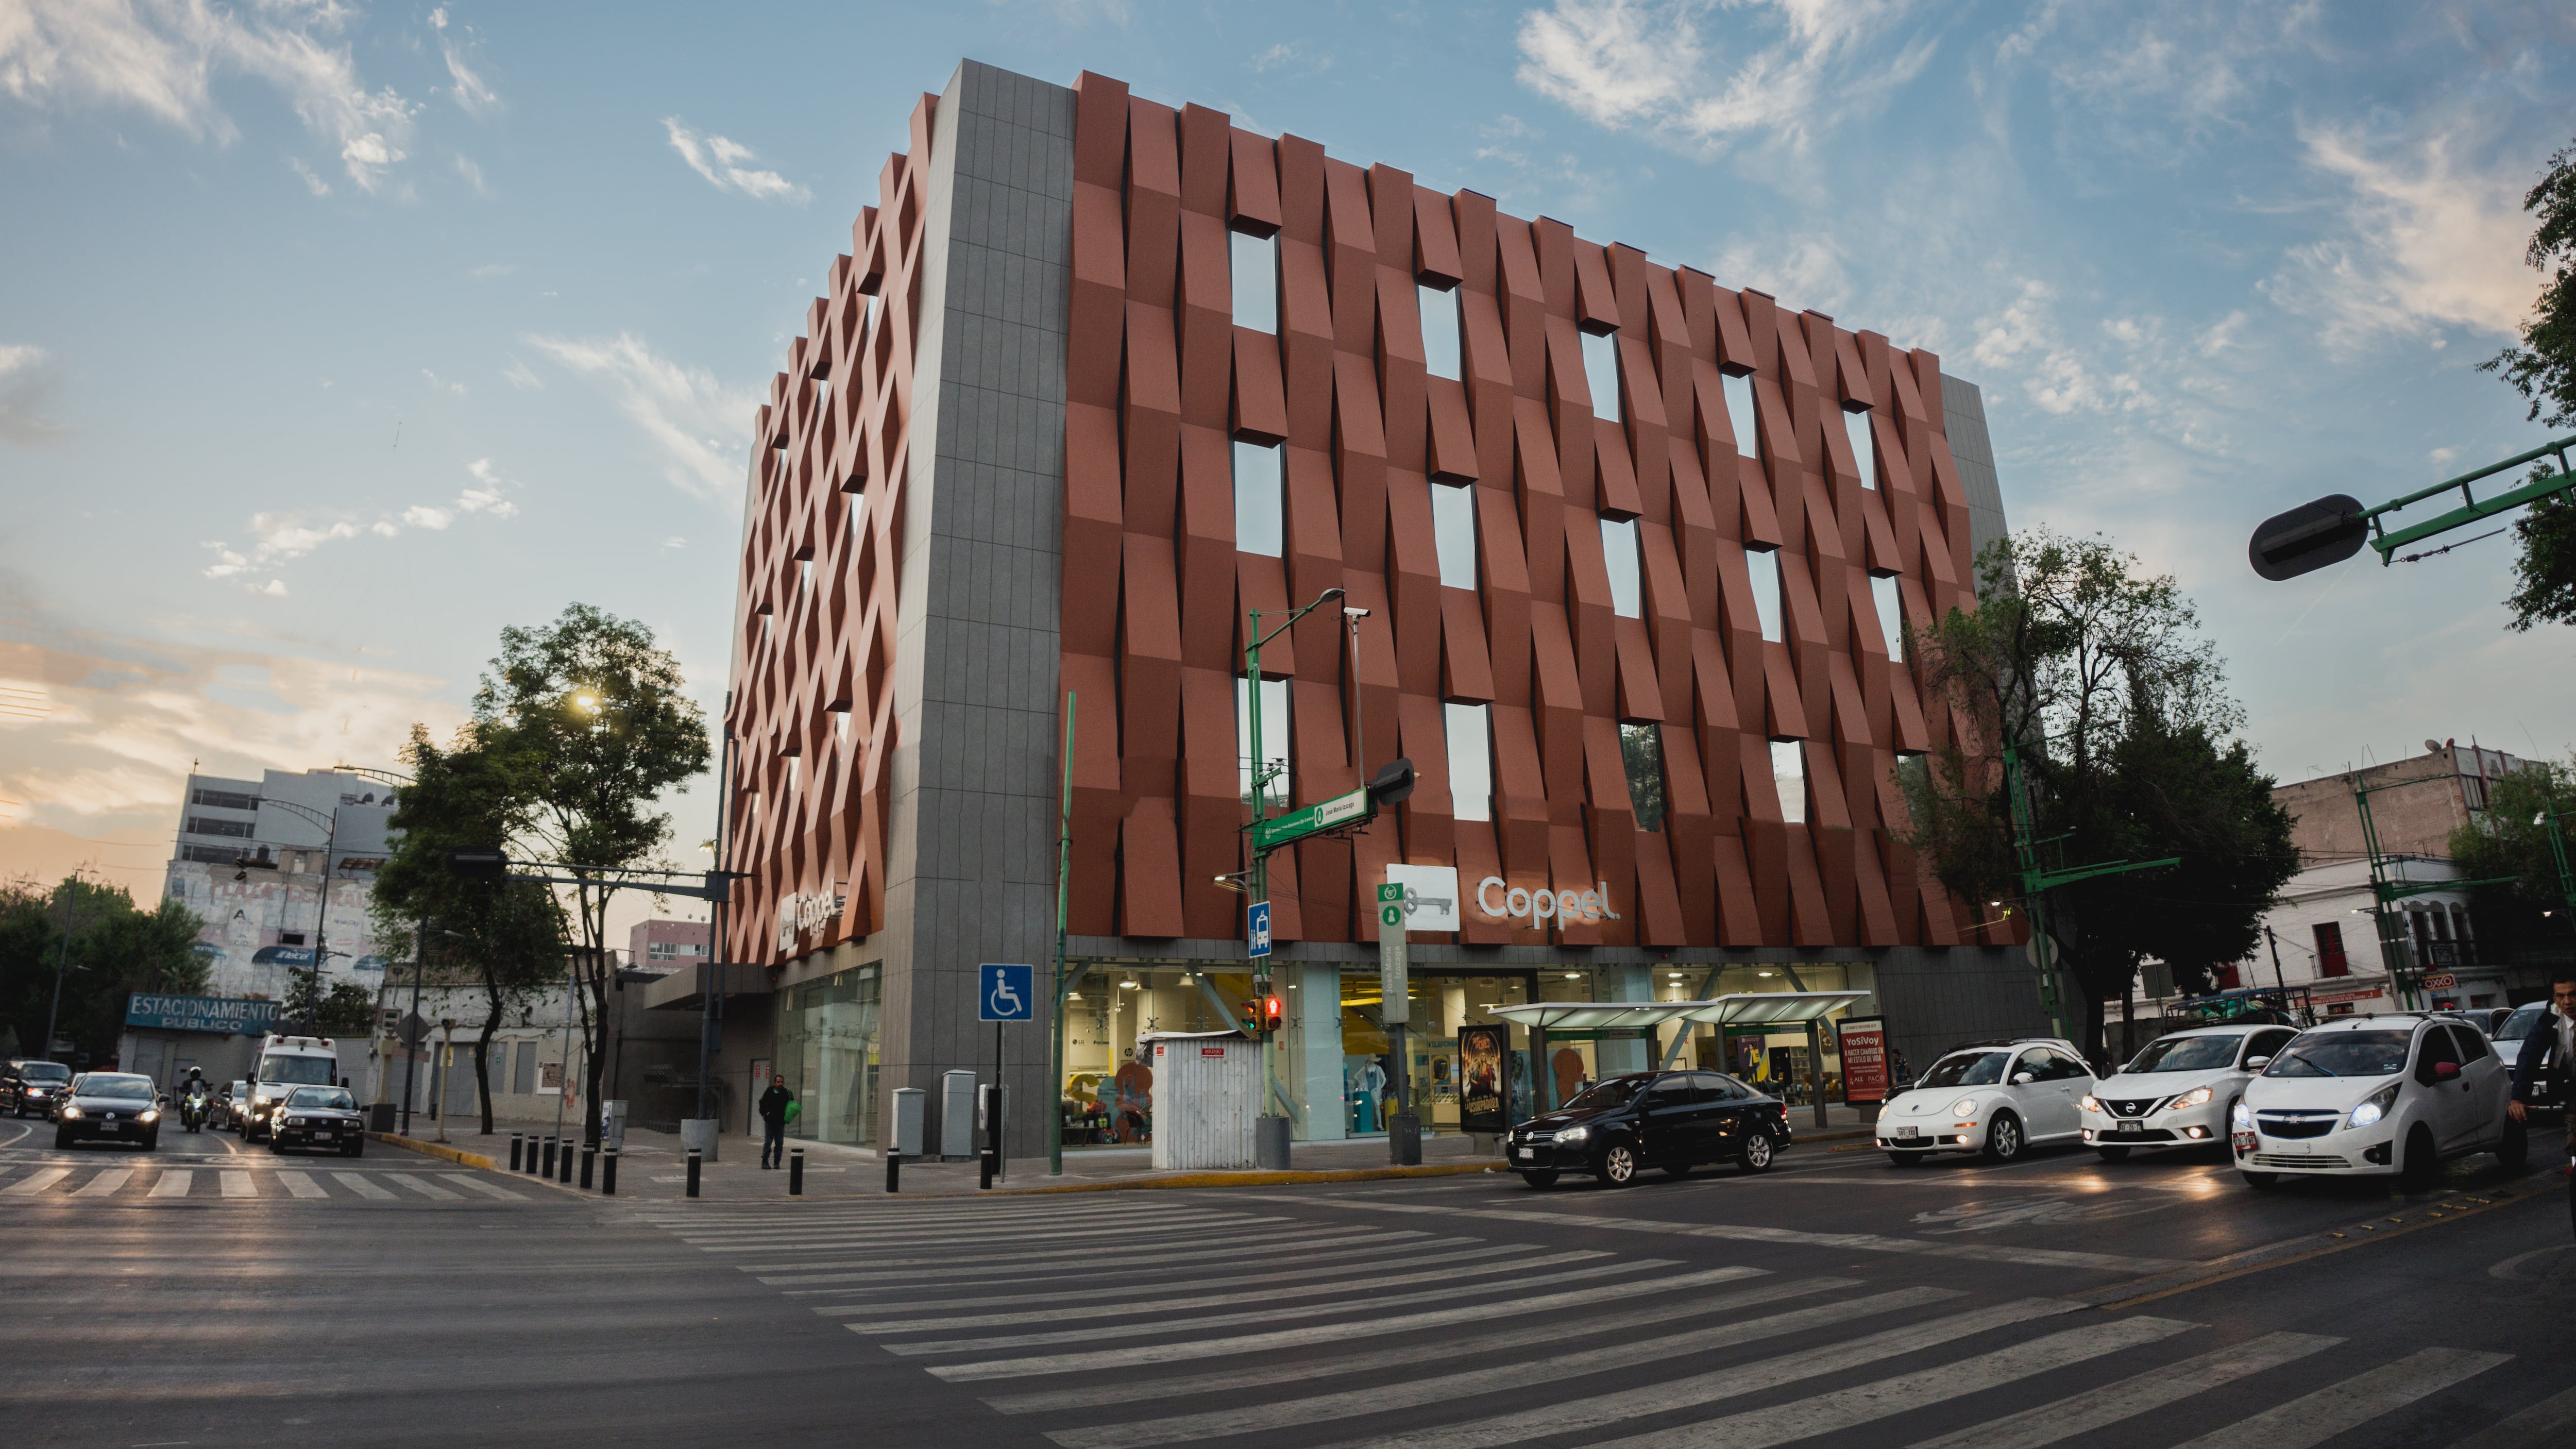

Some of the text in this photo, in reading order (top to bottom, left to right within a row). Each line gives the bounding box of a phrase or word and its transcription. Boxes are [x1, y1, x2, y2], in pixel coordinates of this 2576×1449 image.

[2425, 976, 2452, 988] OXXO
[131, 996, 277, 1021] ESTACIONAMIENTO
[1846, 1036, 1878, 1046] YoSíVoy
[1860, 1047, 1878, 1055] CAMBIOS
[1469, 1097, 1500, 1113] USURPADORA
